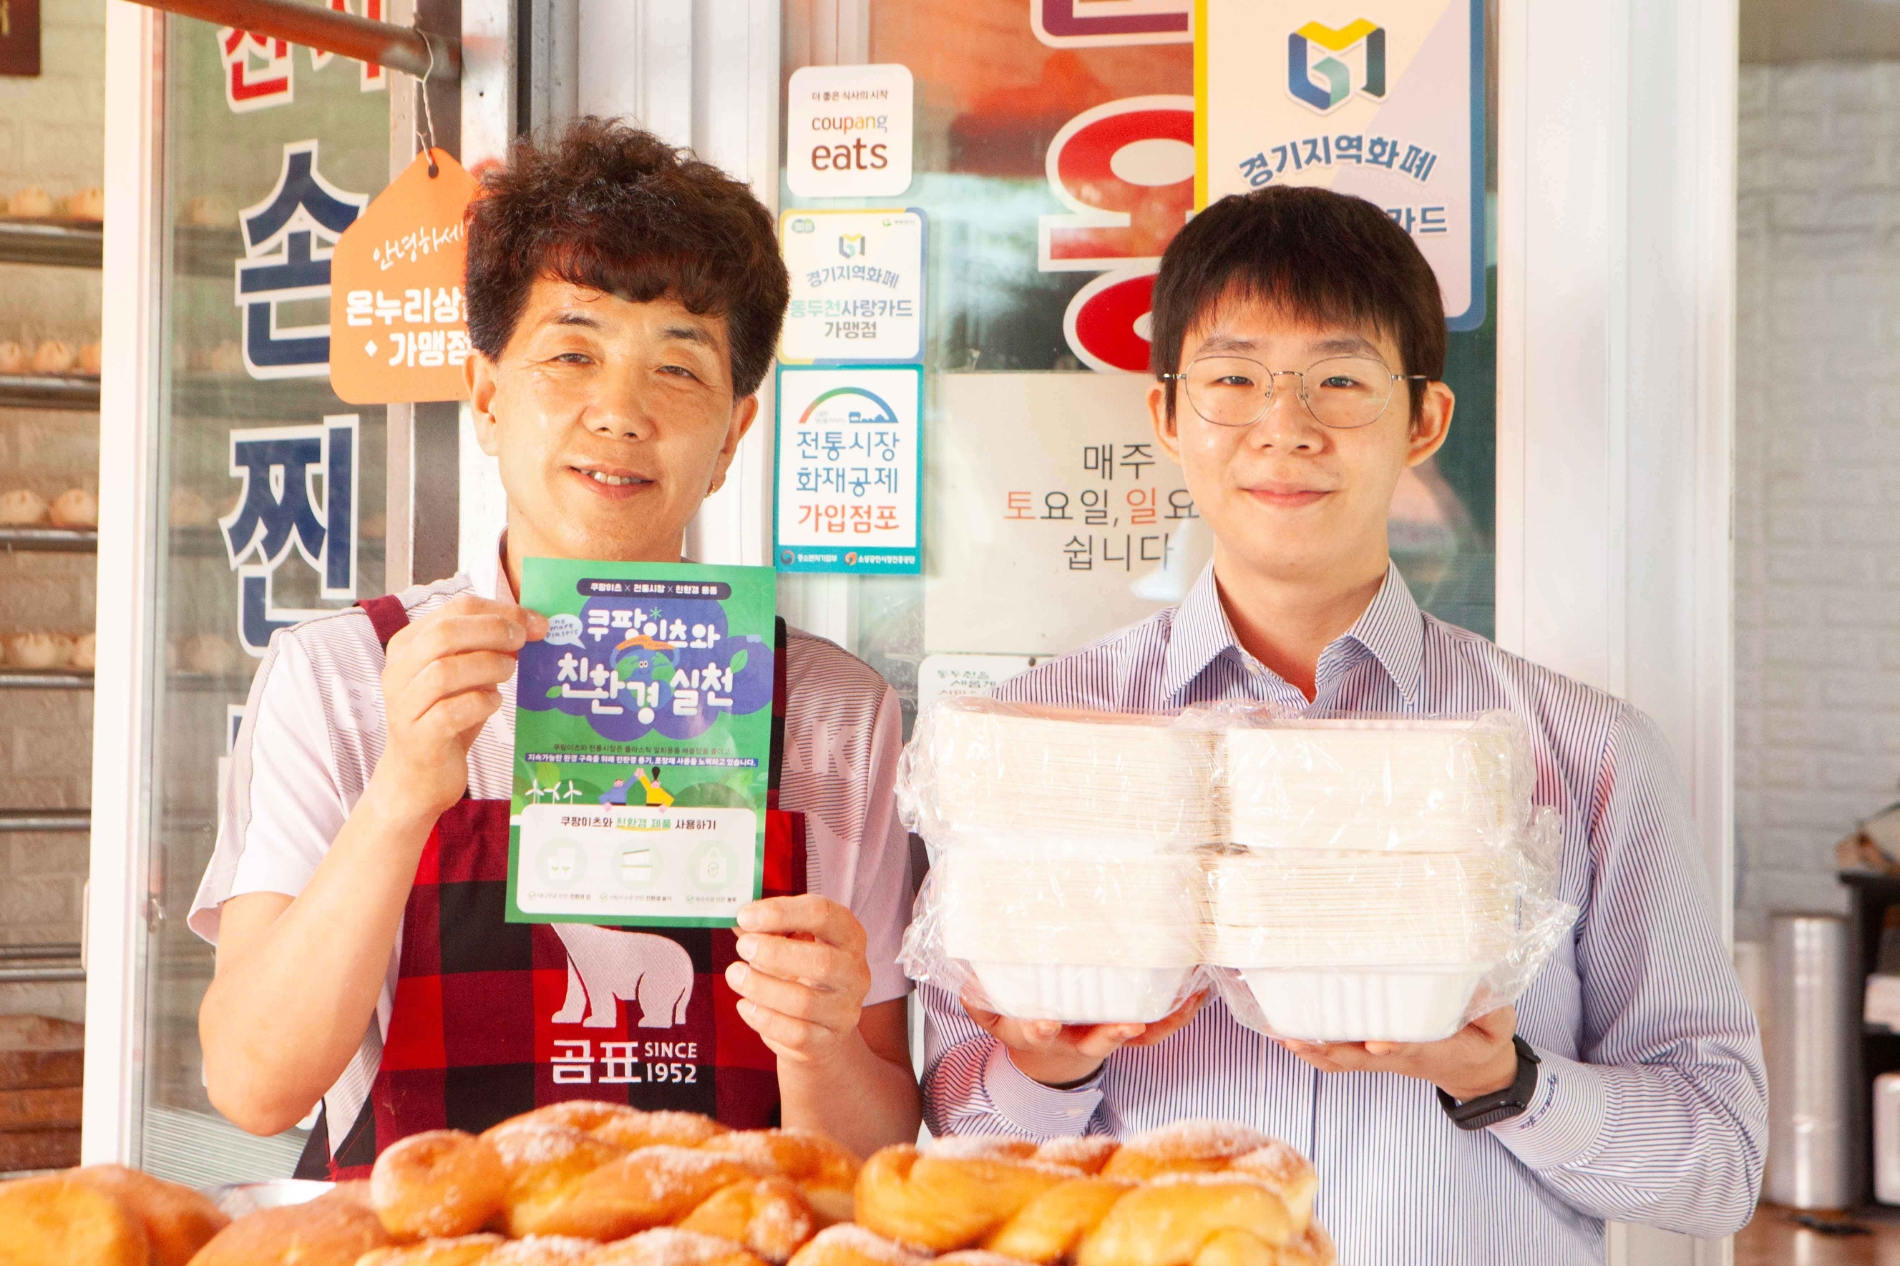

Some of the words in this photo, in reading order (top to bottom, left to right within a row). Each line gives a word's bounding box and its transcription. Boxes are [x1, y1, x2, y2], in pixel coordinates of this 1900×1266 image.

[870, 89, 888, 100] 시작
[811, 115, 888, 135] coupang
[811, 137, 888, 171] eats
[1238, 134, 1438, 187] 경기지역화폐
[1386, 206, 1447, 234] 카드
[373, 219, 466, 272] 안녕하세
[806, 265, 900, 289] 경기지역화폐
[346, 286, 469, 326] 온누리상
[790, 299, 913, 318] 동두천사랑카드
[824, 321, 877, 339] 가맹점
[797, 430, 900, 461] 전통시장
[1083, 443, 1155, 481] 매주
[796, 467, 898, 497] 화재공제
[798, 504, 900, 534] 가입점포
[1002, 487, 1200, 528] 토요일,일요
[1063, 533, 1175, 572] 쉽니다
[590, 582, 623, 592] 쿠팡이츠
[546, 629, 579, 639] plastic
[587, 607, 721, 649] 쿠팡이츠와
[557, 652, 660, 725] 친환경
[669, 662, 734, 716] 실천
[560, 816, 613, 828] 쿠팡이츠와
[616, 816, 648, 828] 친환경
[651, 817, 671, 829] 제품
[675, 819, 717, 830] 사용하기
[550, 1039, 642, 1084] 곰표
[644, 1041, 698, 1059] SINCE
[646, 1062, 697, 1084] 1952
